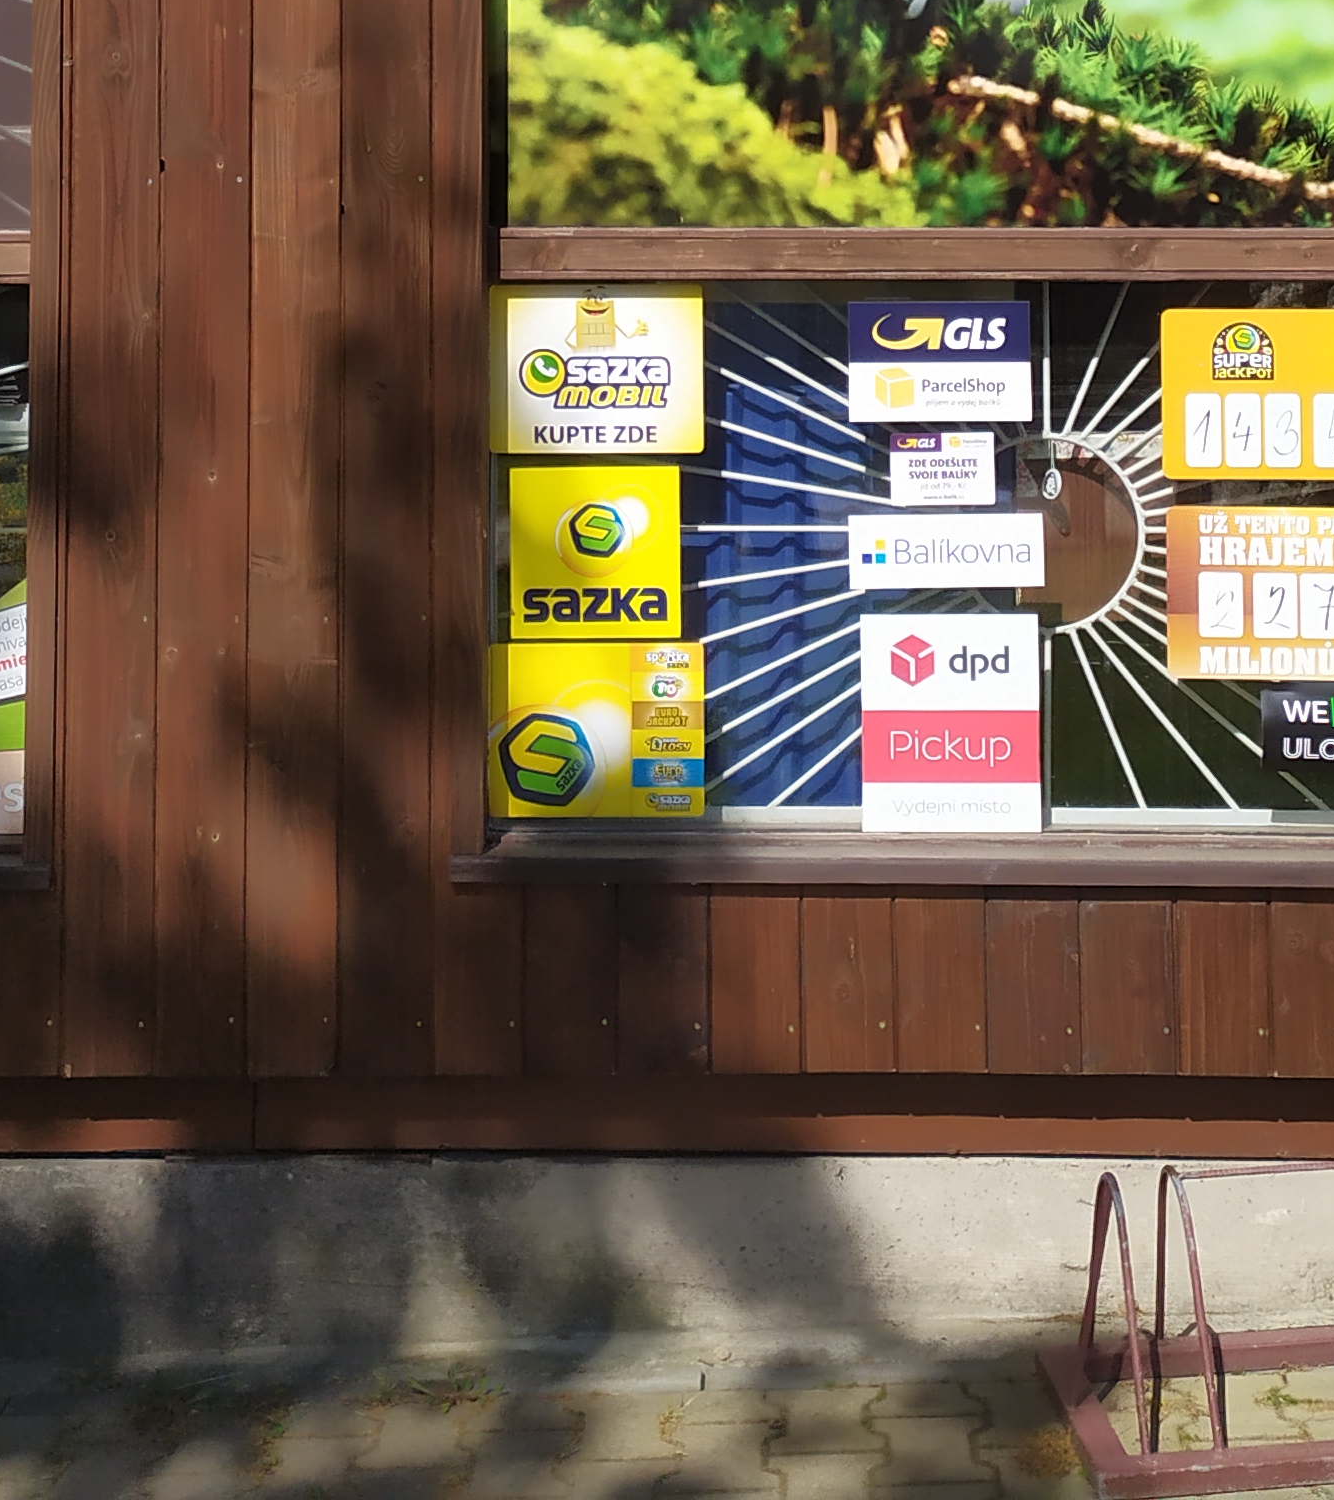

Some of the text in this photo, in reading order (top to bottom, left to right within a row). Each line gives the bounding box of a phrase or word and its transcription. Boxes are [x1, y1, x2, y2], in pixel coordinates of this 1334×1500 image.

[944, 317, 1007, 350] GLS
[921, 378, 1006, 396] ParcelShop
[534, 426, 657, 444] KUPTE ZDE
[917, 438, 936, 448] GLS
[909, 457, 978, 467] ZDE ODEŠLETE
[909, 469, 977, 479] SVOJE BALÍKY
[1198, 511, 1228, 534] UŽ
[1235, 515, 1310, 535] TENTO
[894, 538, 1031, 564] Balíkovna
[948, 646, 1009, 681] dpd
[890, 730, 1012, 767] Pickup
